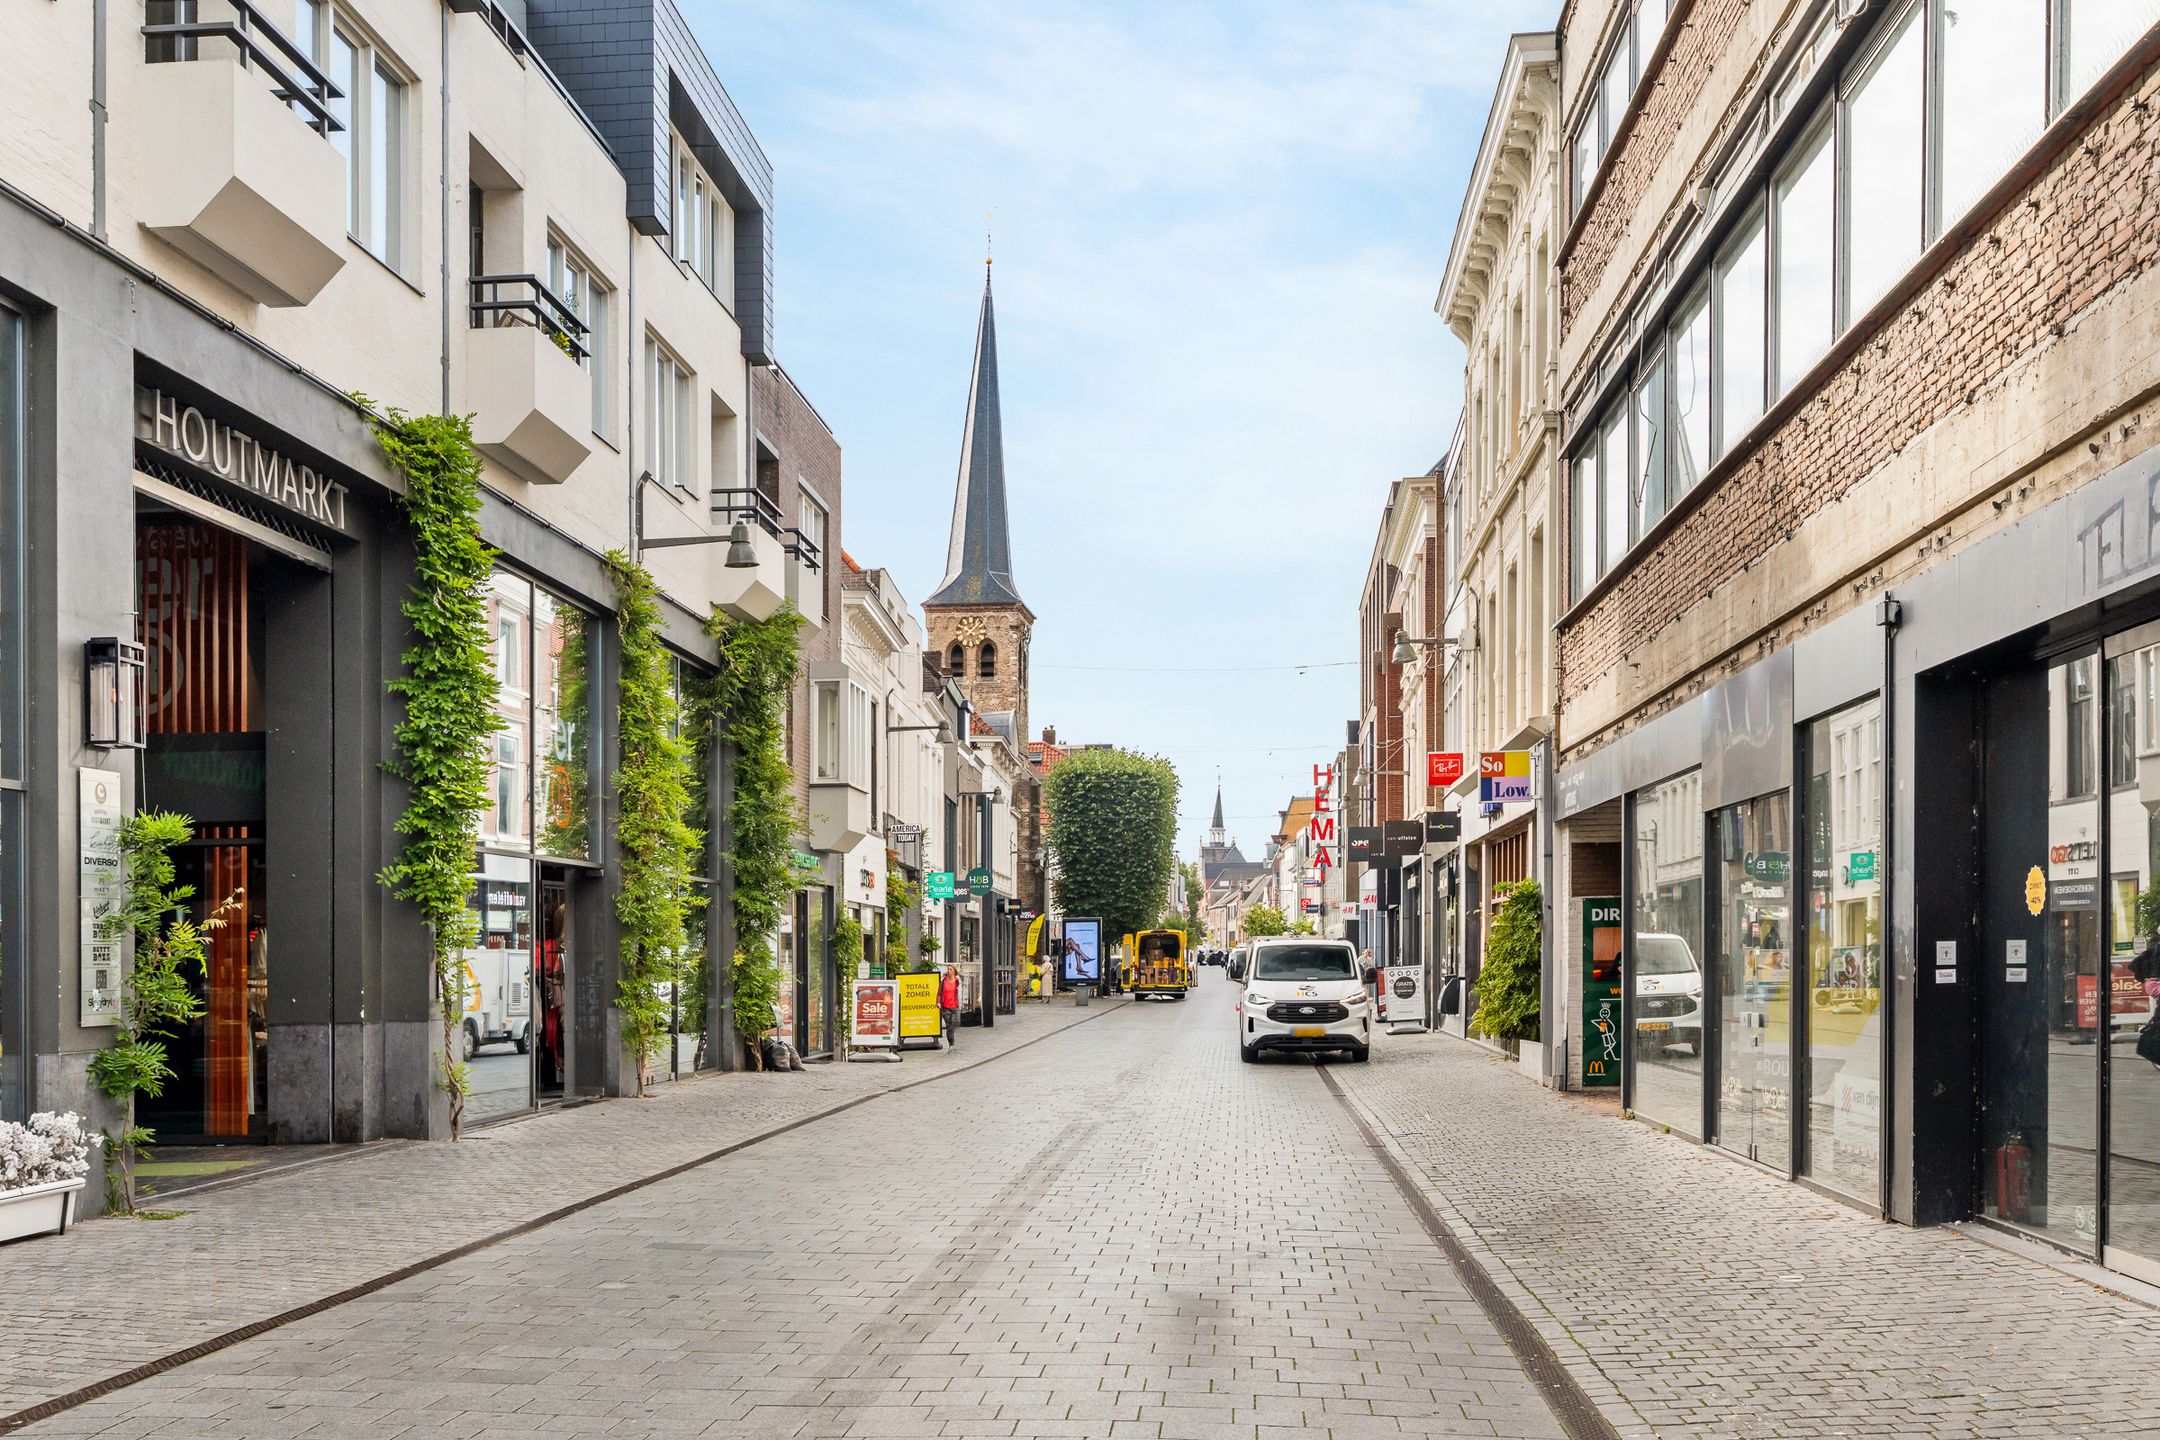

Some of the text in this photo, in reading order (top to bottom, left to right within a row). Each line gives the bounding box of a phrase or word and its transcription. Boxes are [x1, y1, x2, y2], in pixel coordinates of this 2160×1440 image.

[155, 389, 349, 530] HOUTMARKT
[1481, 756, 1504, 773] So
[1311, 763, 1334, 868] HEMA
[891, 824, 921, 833] AMERICA
[897, 833, 916, 842] TODAY
[84, 857, 118, 867] DIVERSO
[928, 885, 953, 893] Pearle
[862, 1002, 888, 1013] Sale
